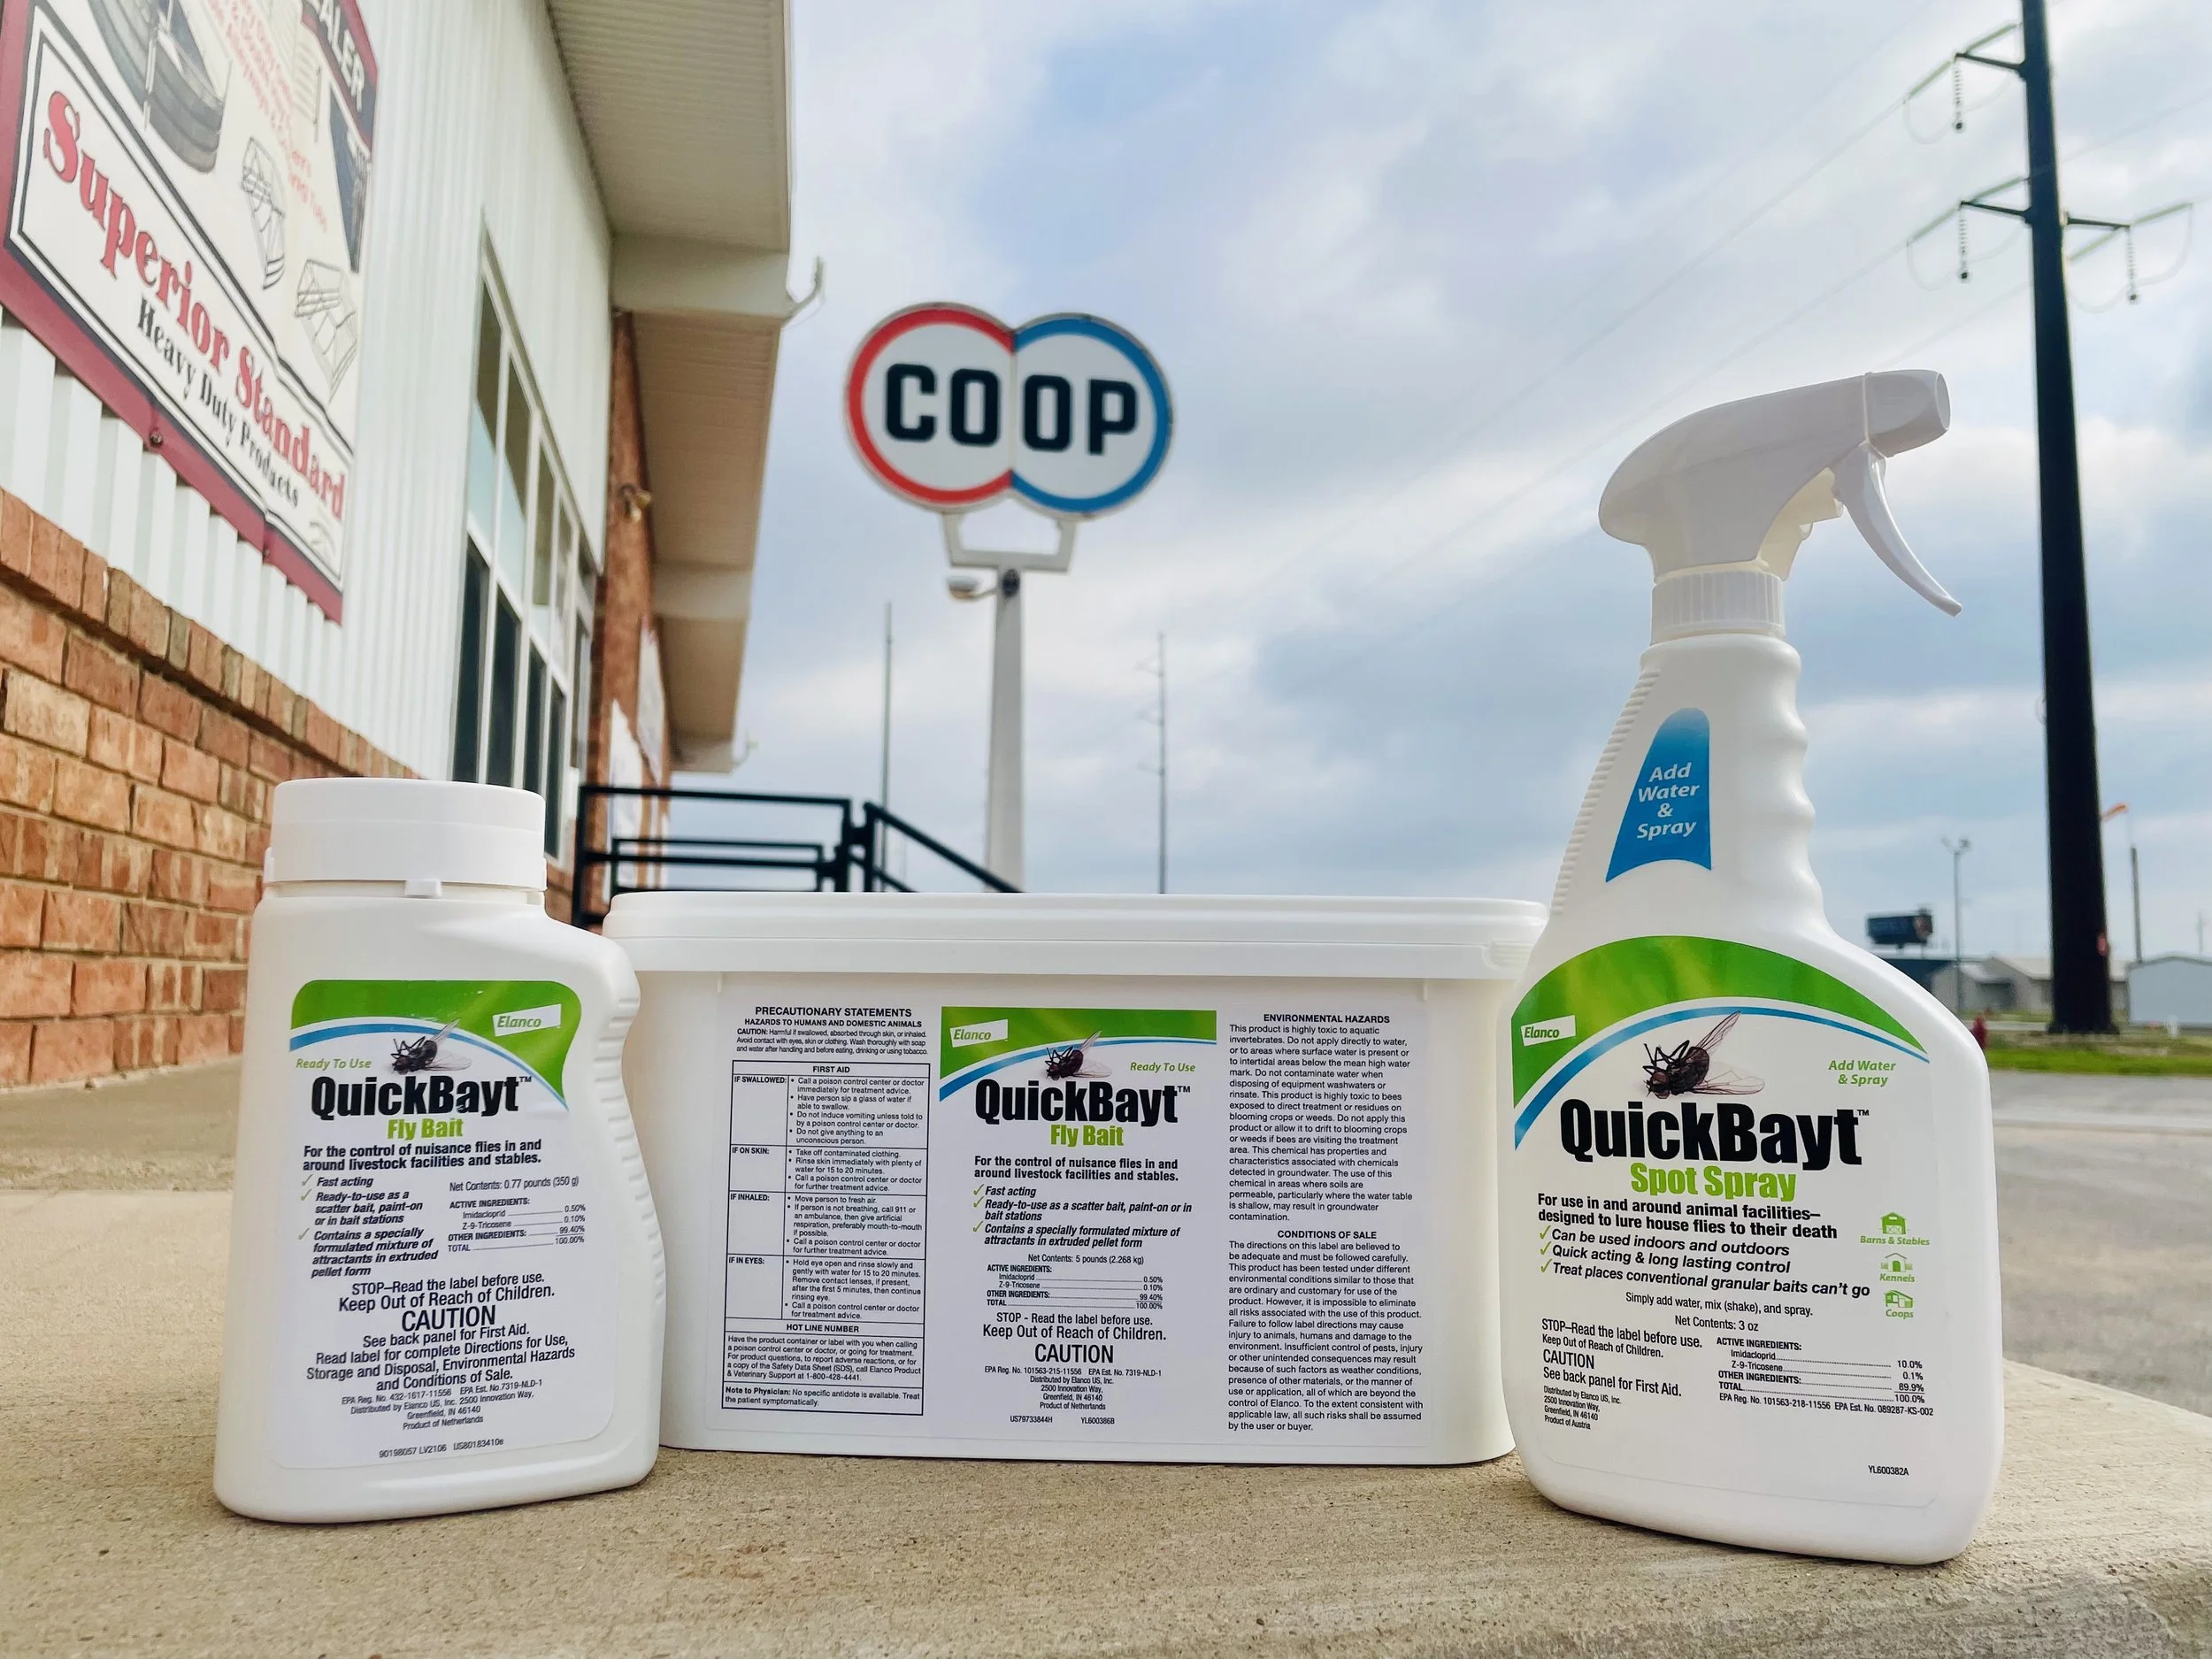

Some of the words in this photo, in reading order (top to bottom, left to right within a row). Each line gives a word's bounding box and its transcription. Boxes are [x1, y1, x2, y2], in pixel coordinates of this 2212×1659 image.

[43, 91, 232, 374] Superior
[236, 344, 345, 522] Standard
[136, 291, 196, 397] Heavy
[200, 370, 236, 444] Duty
[240, 422, 300, 508] Products
[886, 363, 1138, 456] COOP
[1648, 762, 1692, 782] Add
[1638, 785, 1700, 803] Water
[1657, 803, 1673, 818] &
[1637, 821, 1696, 841] Spray
[756, 1006, 842, 1017] PRECAUTIONARY
[844, 1008, 912, 1018] STATEMENTS
[1263, 1014, 1343, 1023] ENVIRONMENTAL
[1345, 1015, 1390, 1024] HAZARDS
[497, 1016, 541, 1028] Elanco
[953, 1029, 992, 1041] Elanco
[1523, 1025, 1560, 1040] Elanco
[296, 1058, 330, 1071] Ready
[334, 1058, 347, 1069] To
[349, 1058, 372, 1069] Use
[1130, 1062, 1162, 1073] Ready
[1164, 1063, 1176, 1071] To
[1178, 1063, 1195, 1072] Use
[1828, 1060, 1855, 1071] Add
[1857, 1060, 1896, 1071] Water
[1838, 1074, 1848, 1085] &
[1850, 1074, 1888, 1087] Spray
[388, 1119, 417, 1141] Fly
[421, 1118, 464, 1138] Bait
[1051, 1125, 1079, 1148] Fly
[1083, 1125, 1124, 1146] Bait
[303, 1145, 323, 1157] For
[326, 1146, 346, 1157] the
[349, 1144, 396, 1157] control
[399, 1143, 412, 1156] of
[415, 1142, 472, 1156] nuisance
[475, 1141, 501, 1153] flies
[504, 1140, 516, 1152] in
[519, 1139, 541, 1151] and
[303, 1159, 345, 1171] around
[349, 1157, 407, 1171] livestock
[411, 1155, 465, 1169] facilities
[468, 1154, 491, 1166] and
[495, 1153, 541, 1165] stables.
[975, 1156, 992, 1166] For
[995, 1156, 1011, 1166] the
[1015, 1156, 1052, 1167] control
[1056, 1156, 1066, 1167] of
[1069, 1157, 1117, 1169] nuisance
[1119, 1158, 1142, 1169] flies
[1145, 1158, 1155, 1169] in
[1158, 1159, 1178, 1170] and
[317, 1177, 339, 1187] Fast
[341, 1176, 374, 1188] acting
[974, 1168, 1011, 1179] around
[1015, 1168, 1063, 1179] livestock
[1065, 1169, 1111, 1180] facilities
[1114, 1171, 1133, 1180] and
[1137, 1171, 1179, 1181] stables.
[1630, 1163, 1699, 1196] Spot
[1703, 1165, 1796, 1202] Spray
[449, 1182, 464, 1192] Net
[465, 1180, 503, 1191] Contents:
[503, 1179, 522, 1189] 0.77
[524, 1178, 551, 1190] pounds
[553, 1176, 570, 1187] (350
[572, 1176, 579, 1187] g)
[985, 1186, 1006, 1196] Fast
[1007, 1187, 1037, 1199] acting
[1538, 1193, 1558, 1206] For
[1561, 1197, 1584, 1208] use
[1587, 1196, 1600, 1210] in
[1603, 1198, 1628, 1211] and
[1632, 1202, 1682, 1215] around
[1686, 1202, 1738, 1217] animal
[1539, 1209, 1594, 1226] designed
[1598, 1213, 1612, 1226] to
[1616, 1214, 1642, 1229] lure
[1646, 1216, 1689, 1232] house
[1693, 1219, 1726, 1233] flies
[1729, 1221, 1746, 1234] to
[1749, 1222, 1787, 1237] their
[1793, 1224, 1838, 1239] death
[1278, 1230, 1336, 1239] CONDITIONS
[1353, 1231, 1377, 1240] SALE
[1552, 1228, 1576, 1241] Can
[1579, 1231, 1595, 1243] be
[1599, 1234, 1631, 1246] used
[1633, 1234, 1686, 1250] indoors
[1689, 1240, 1717, 1252] and
[1721, 1242, 1790, 1256] outdoors
[1860, 1235, 1886, 1244] Barns
[1887, 1236, 1895, 1245] &
[1897, 1237, 1930, 1246] Stables
[1041, 1254, 1073, 1263] Contents:
[1082, 1256, 1108, 1264] pounds
[1109, 1256, 1132, 1265] (2.268
[1133, 1256, 1144, 1265] kg)
[1551, 1244, 1588, 1261] Quick
[1591, 1249, 1632, 1265] acting
[1635, 1251, 1645, 1264] &
[1648, 1253, 1678, 1269] long
[1682, 1255, 1732, 1271] lasting
[1736, 1260, 1791, 1273] control
[426, 1279, 446, 1291] the
[449, 1276, 479, 1289] label
[481, 1274, 518, 1287] before
[522, 1273, 544, 1284] use.
[1553, 1262, 1583, 1276] Treat
[1585, 1265, 1624, 1280] places
[1626, 1271, 1709, 1287] conventional
[1711, 1278, 1770, 1291] granular
[1773, 1279, 1808, 1293] baits
[1852, 1286, 1870, 1299] go
[1879, 1273, 1915, 1283] Kennels
[402, 1304, 495, 1332] CAUTION
[1886, 1307, 1914, 1320] Coops
[1675, 1315, 1691, 1326] Net
[1693, 1317, 1736, 1330] Contents:
[1739, 1320, 1745, 1331] 3
[1747, 1323, 1759, 1332] oz
[1035, 1343, 1113, 1363] CAUTION
[1543, 1348, 1594, 1370] CAUTION
